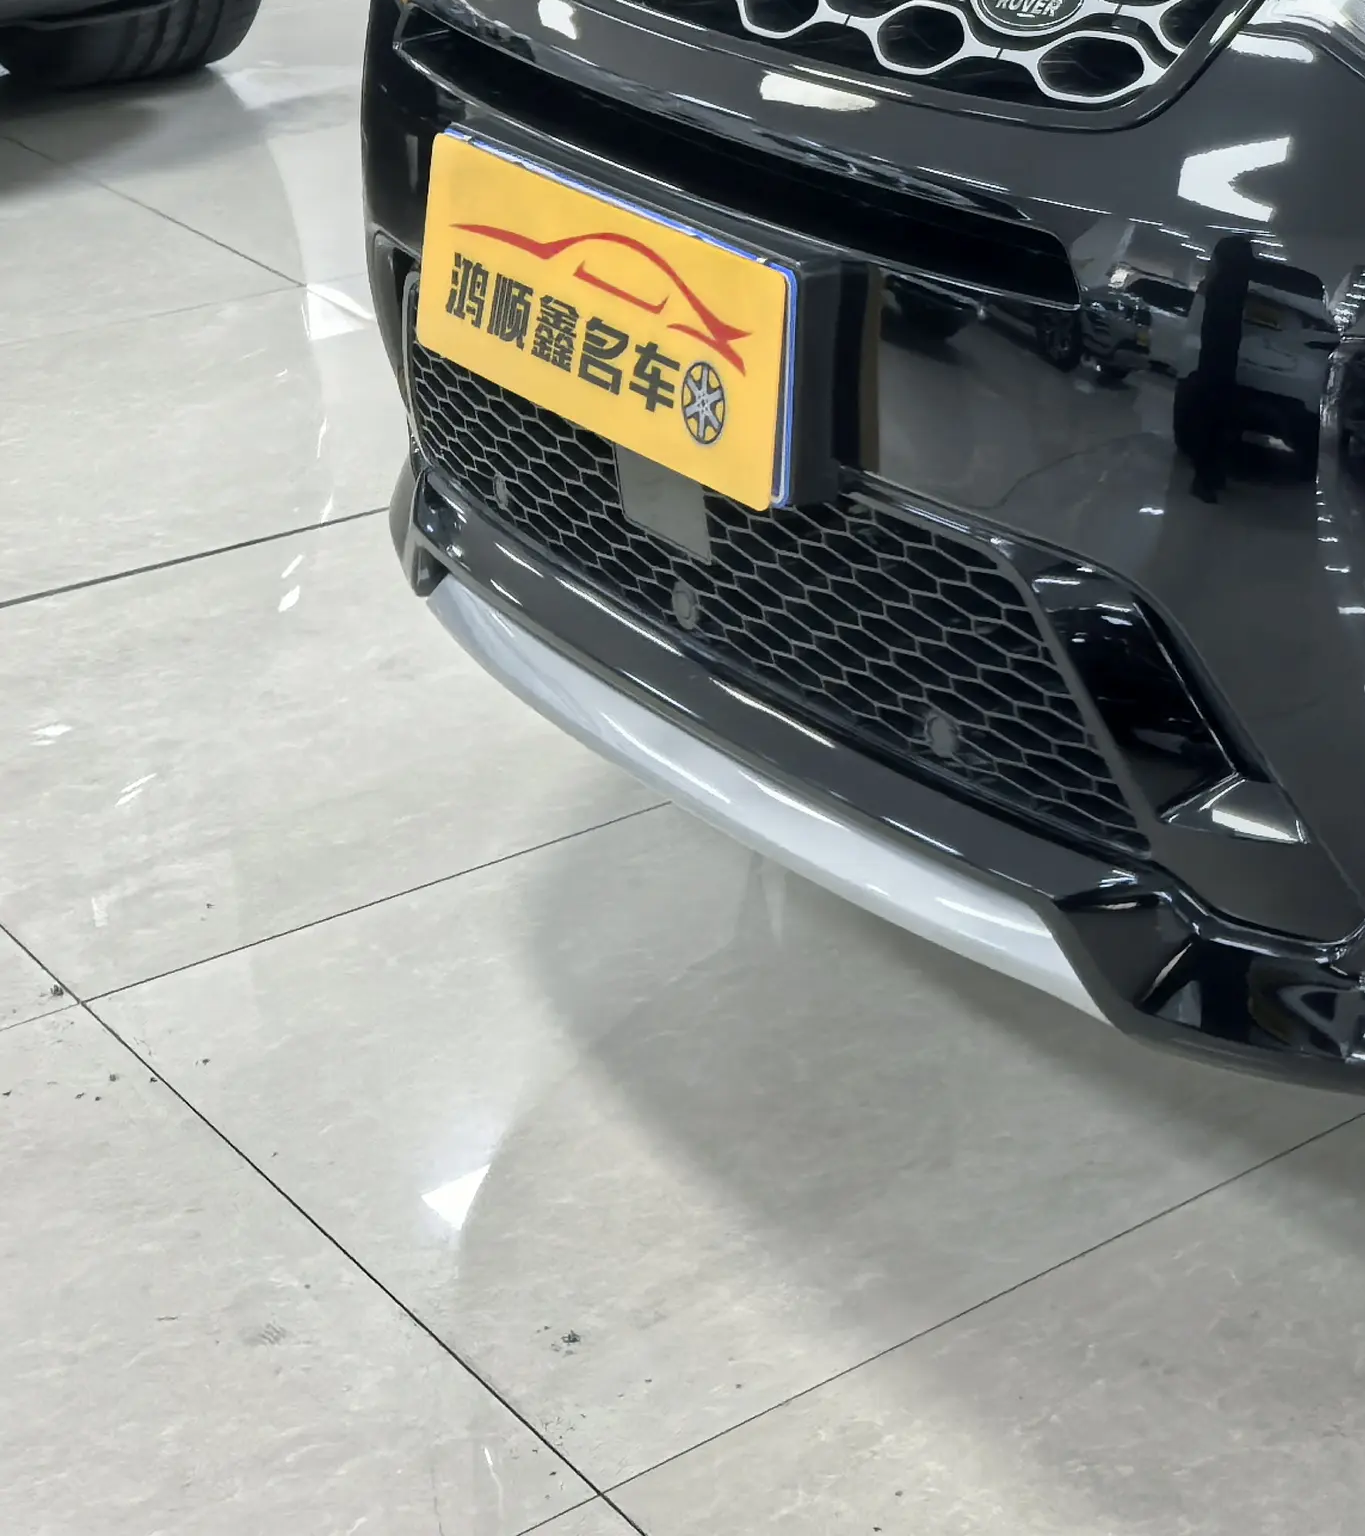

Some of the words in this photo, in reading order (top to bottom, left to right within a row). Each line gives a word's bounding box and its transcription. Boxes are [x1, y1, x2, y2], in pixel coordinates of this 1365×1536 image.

[445, 251, 681, 413] 鸿顺鑫名车
